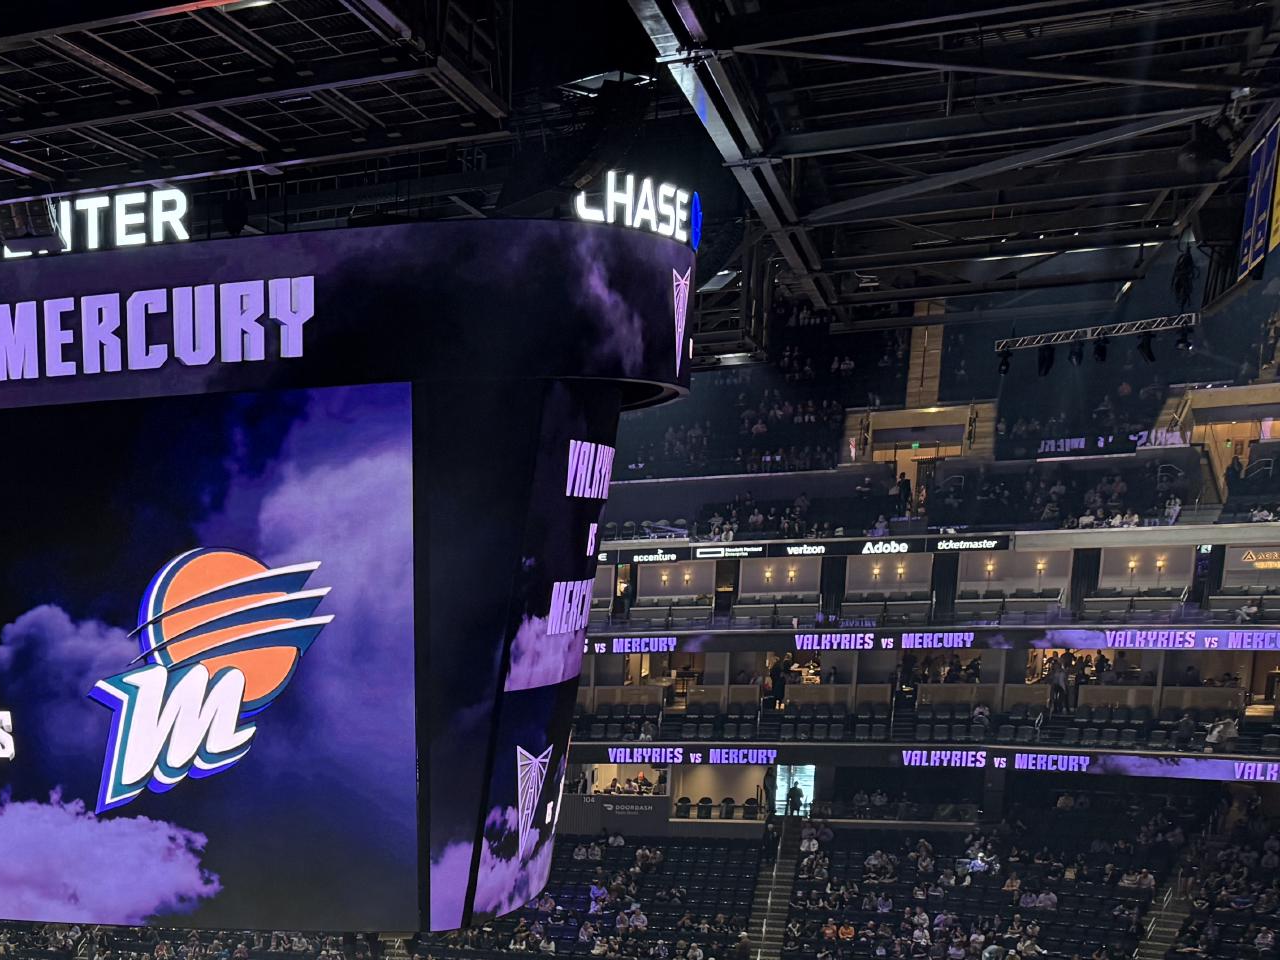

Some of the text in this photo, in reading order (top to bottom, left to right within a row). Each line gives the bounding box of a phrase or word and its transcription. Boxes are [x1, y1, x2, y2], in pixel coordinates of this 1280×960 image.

[787, 544, 825, 555] verizon
[862, 541, 909, 555] Adobe
[937, 539, 997, 550] ticketmaster
[633, 551, 677, 563] accenture
[594, 642, 606, 653] VS
[612, 637, 677, 653] MERCURY
[794, 632, 974, 651] VALKYRIES VS MERCURY
[1105, 630, 1280, 649] VALKYRIES VS MERC
[608, 747, 778, 764] VALKYRIES VS MERCURY
[902, 750, 1090, 772] VALKYRIES VS MERCURY
